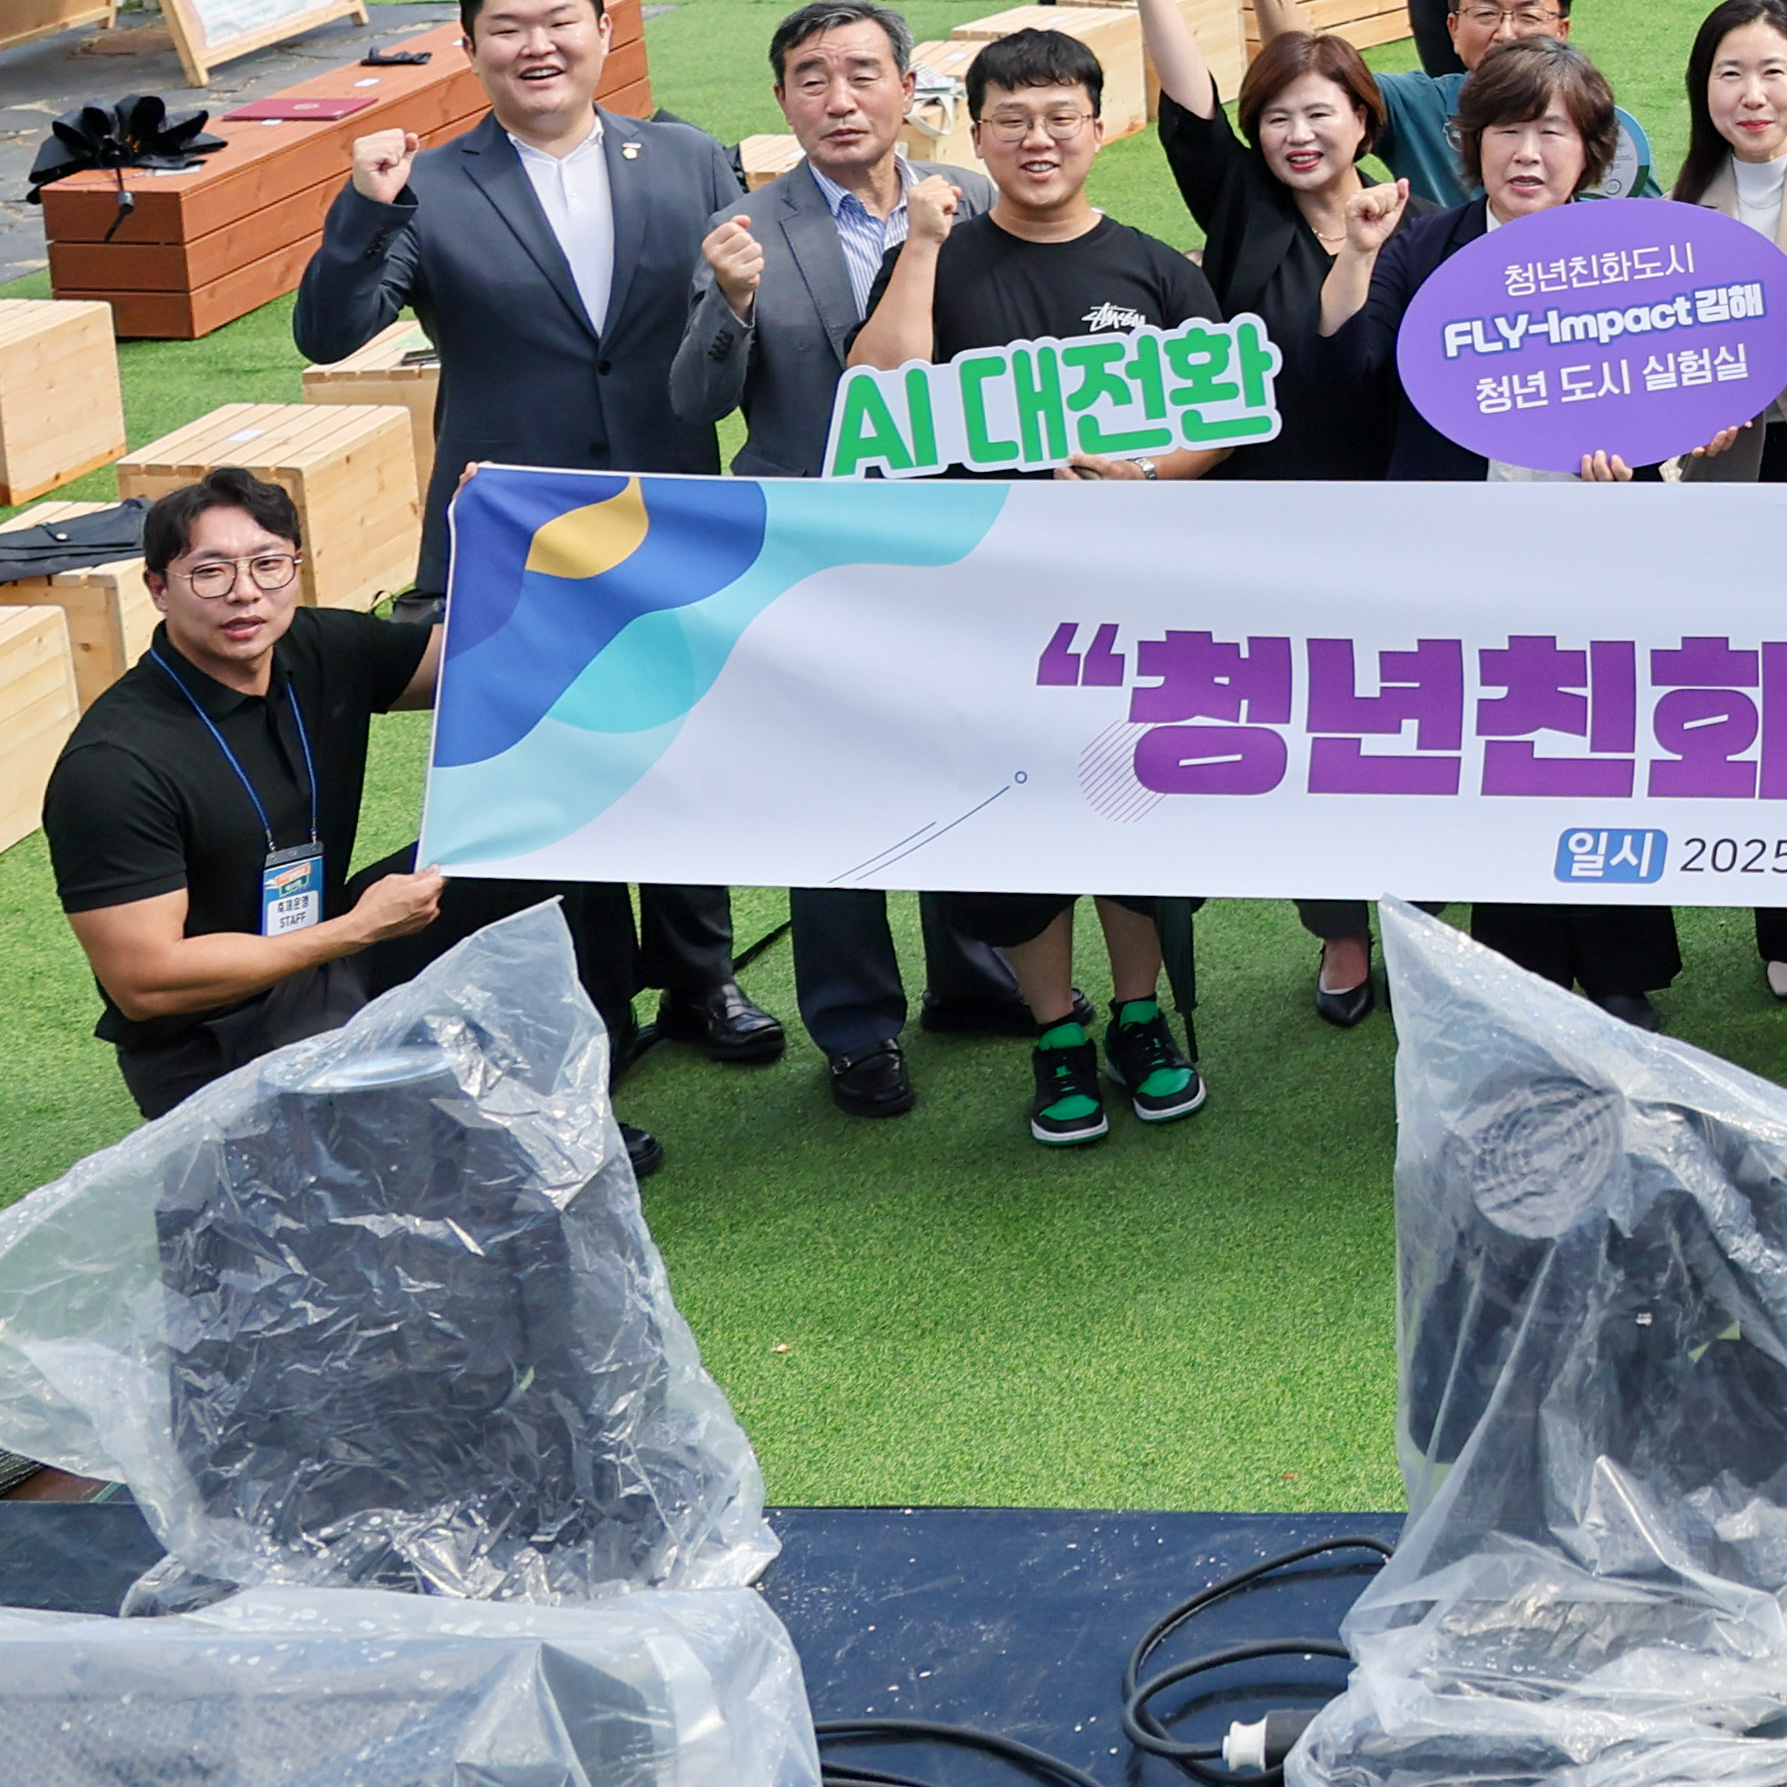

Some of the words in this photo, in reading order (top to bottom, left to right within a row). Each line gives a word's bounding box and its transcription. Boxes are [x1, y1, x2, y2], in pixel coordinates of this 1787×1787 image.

[1504, 240, 1697, 299] 청년친화도시
[1441, 300, 1693, 360] FLY-Impact
[1696, 282, 1764, 325] 김해
[833, 366, 937, 479] AI
[965, 321, 1276, 468] 대전환
[1475, 372, 1549, 416] 청년
[1559, 359, 1632, 403] 도시
[1640, 343, 1750, 393] 실험실
[1563, 829, 1657, 878] 일시
[279, 911, 307, 929] STAFF
